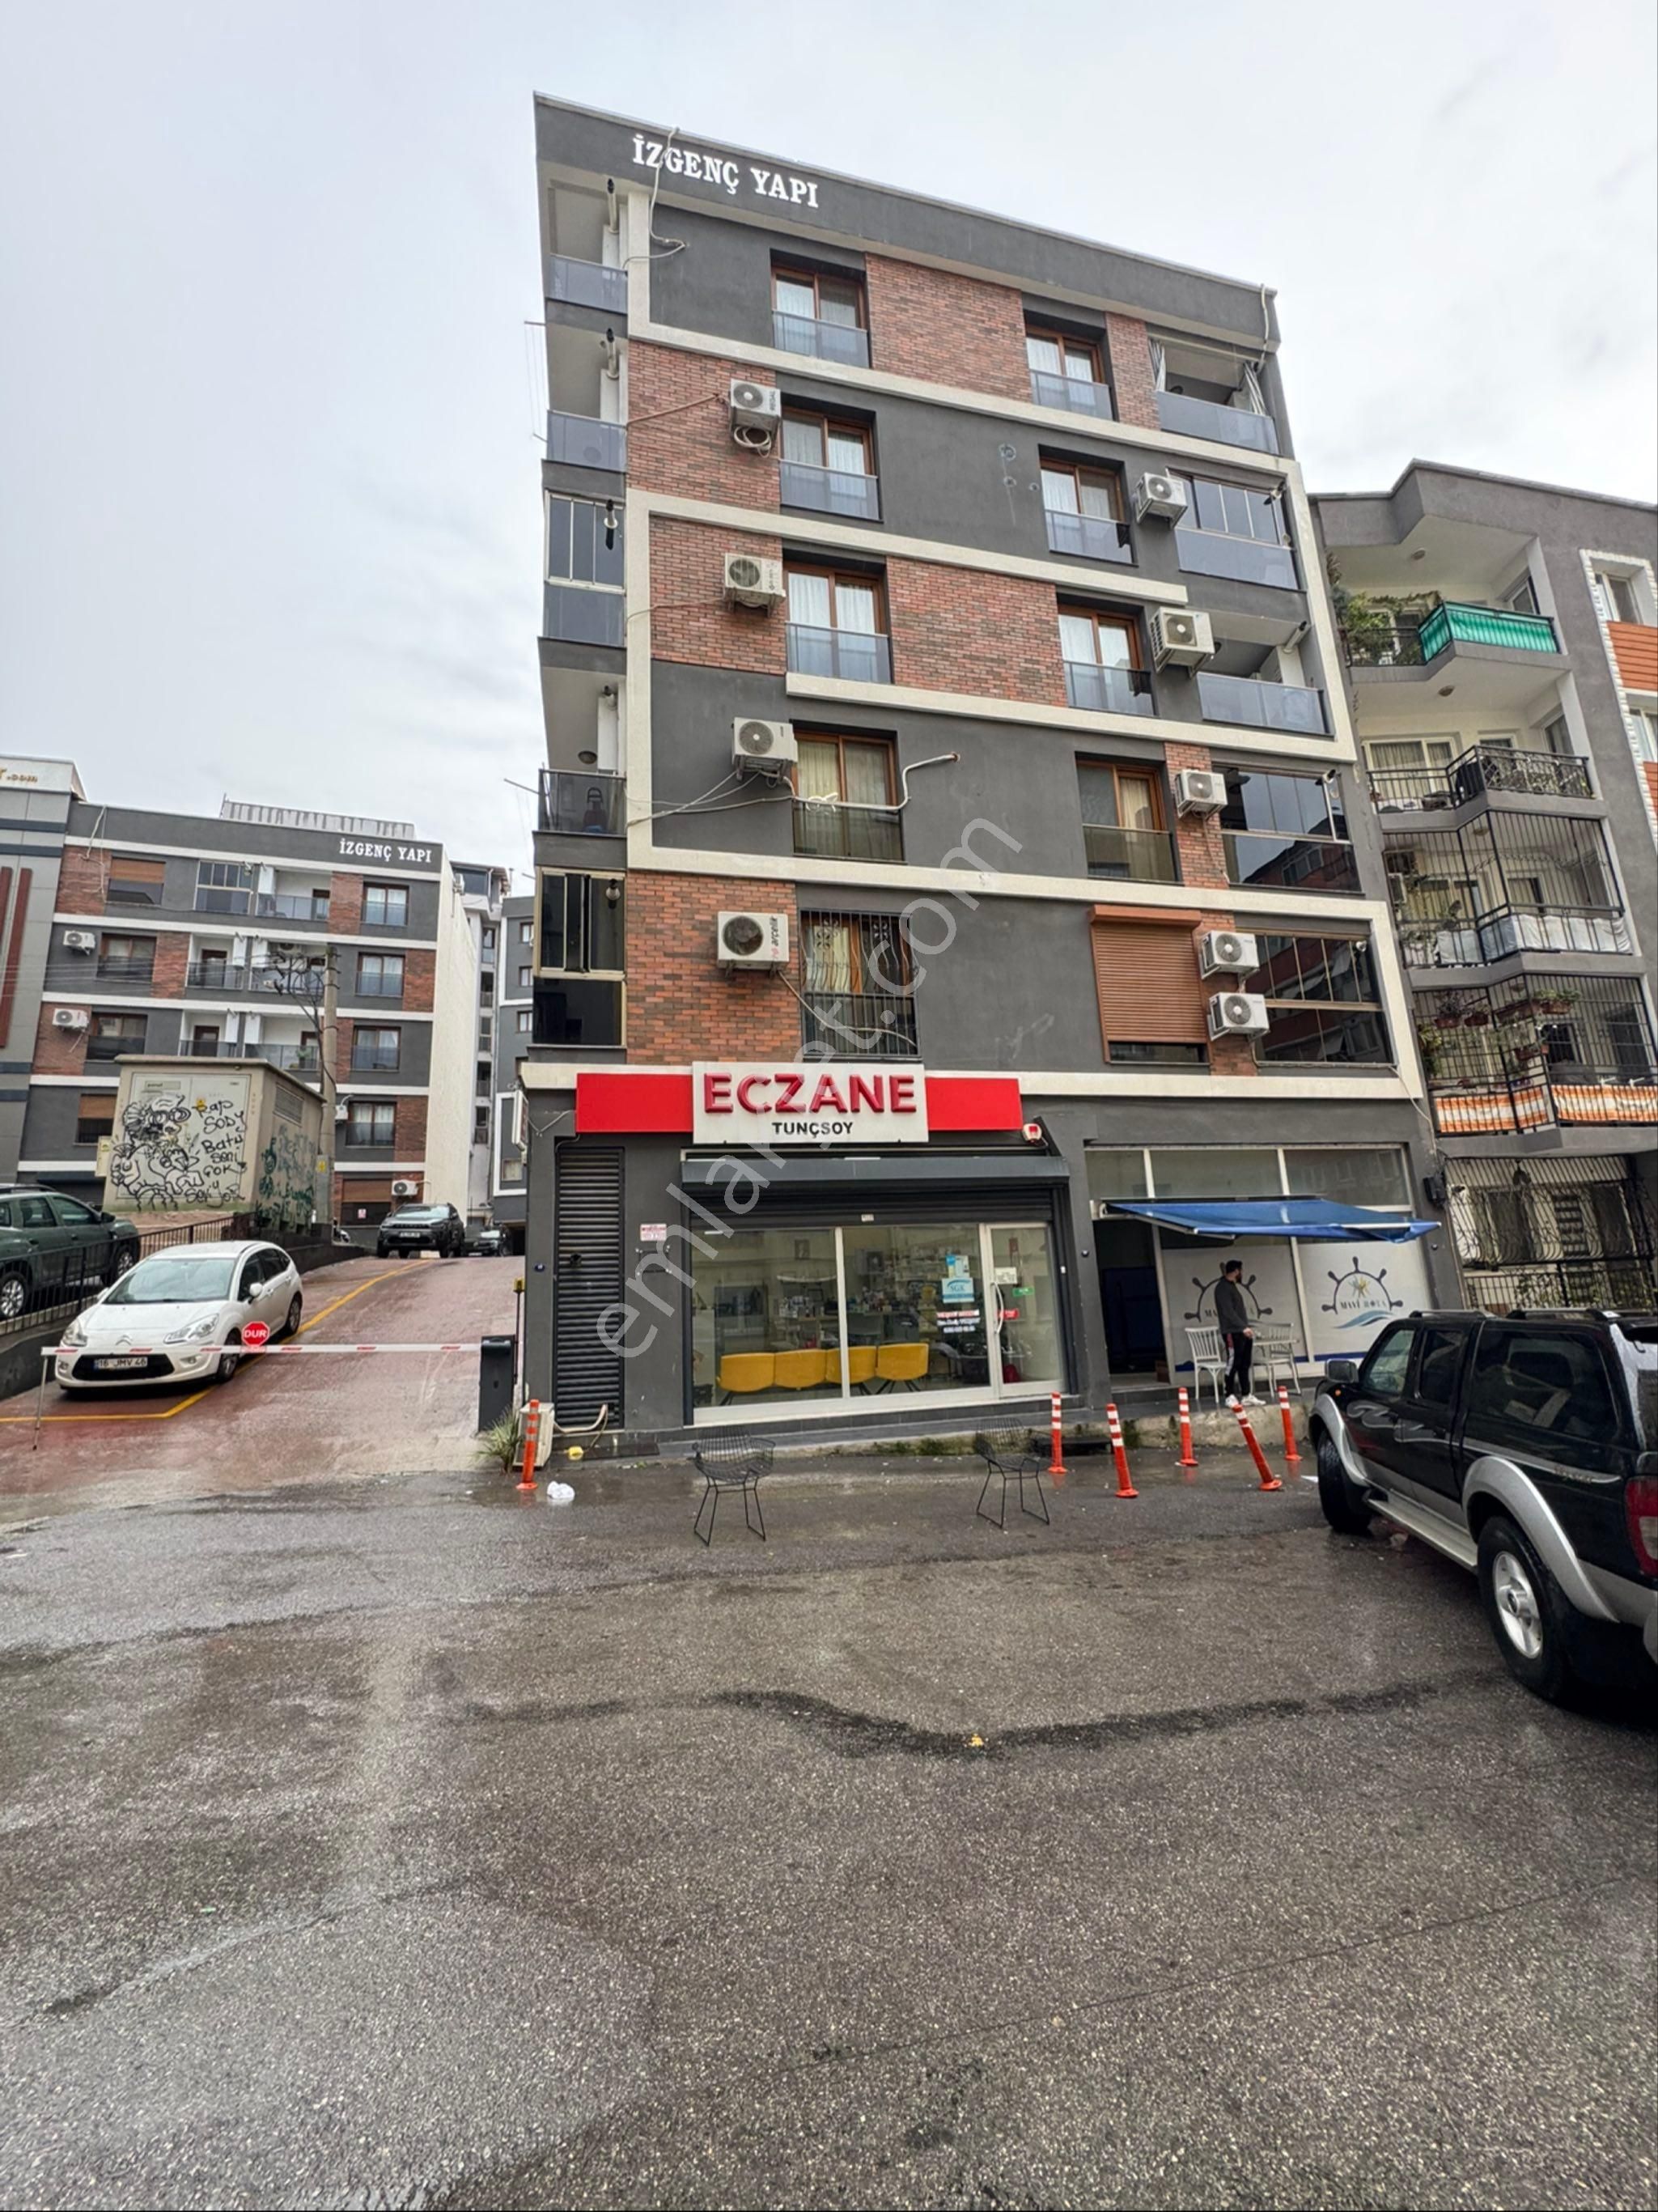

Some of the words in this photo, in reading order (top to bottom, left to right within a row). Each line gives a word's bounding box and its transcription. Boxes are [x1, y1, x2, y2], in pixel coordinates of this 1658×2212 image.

[632, 134, 739, 195] İZGENÇ
[750, 167, 819, 208] YAPI
[340, 838, 392, 862] İZGENÇ
[397, 846, 432, 863] YAPI
[704, 1072, 917, 1114] ECZANE
[772, 1122, 854, 1138] TUNÇSOY
[244, 1329, 268, 1338] DUR
